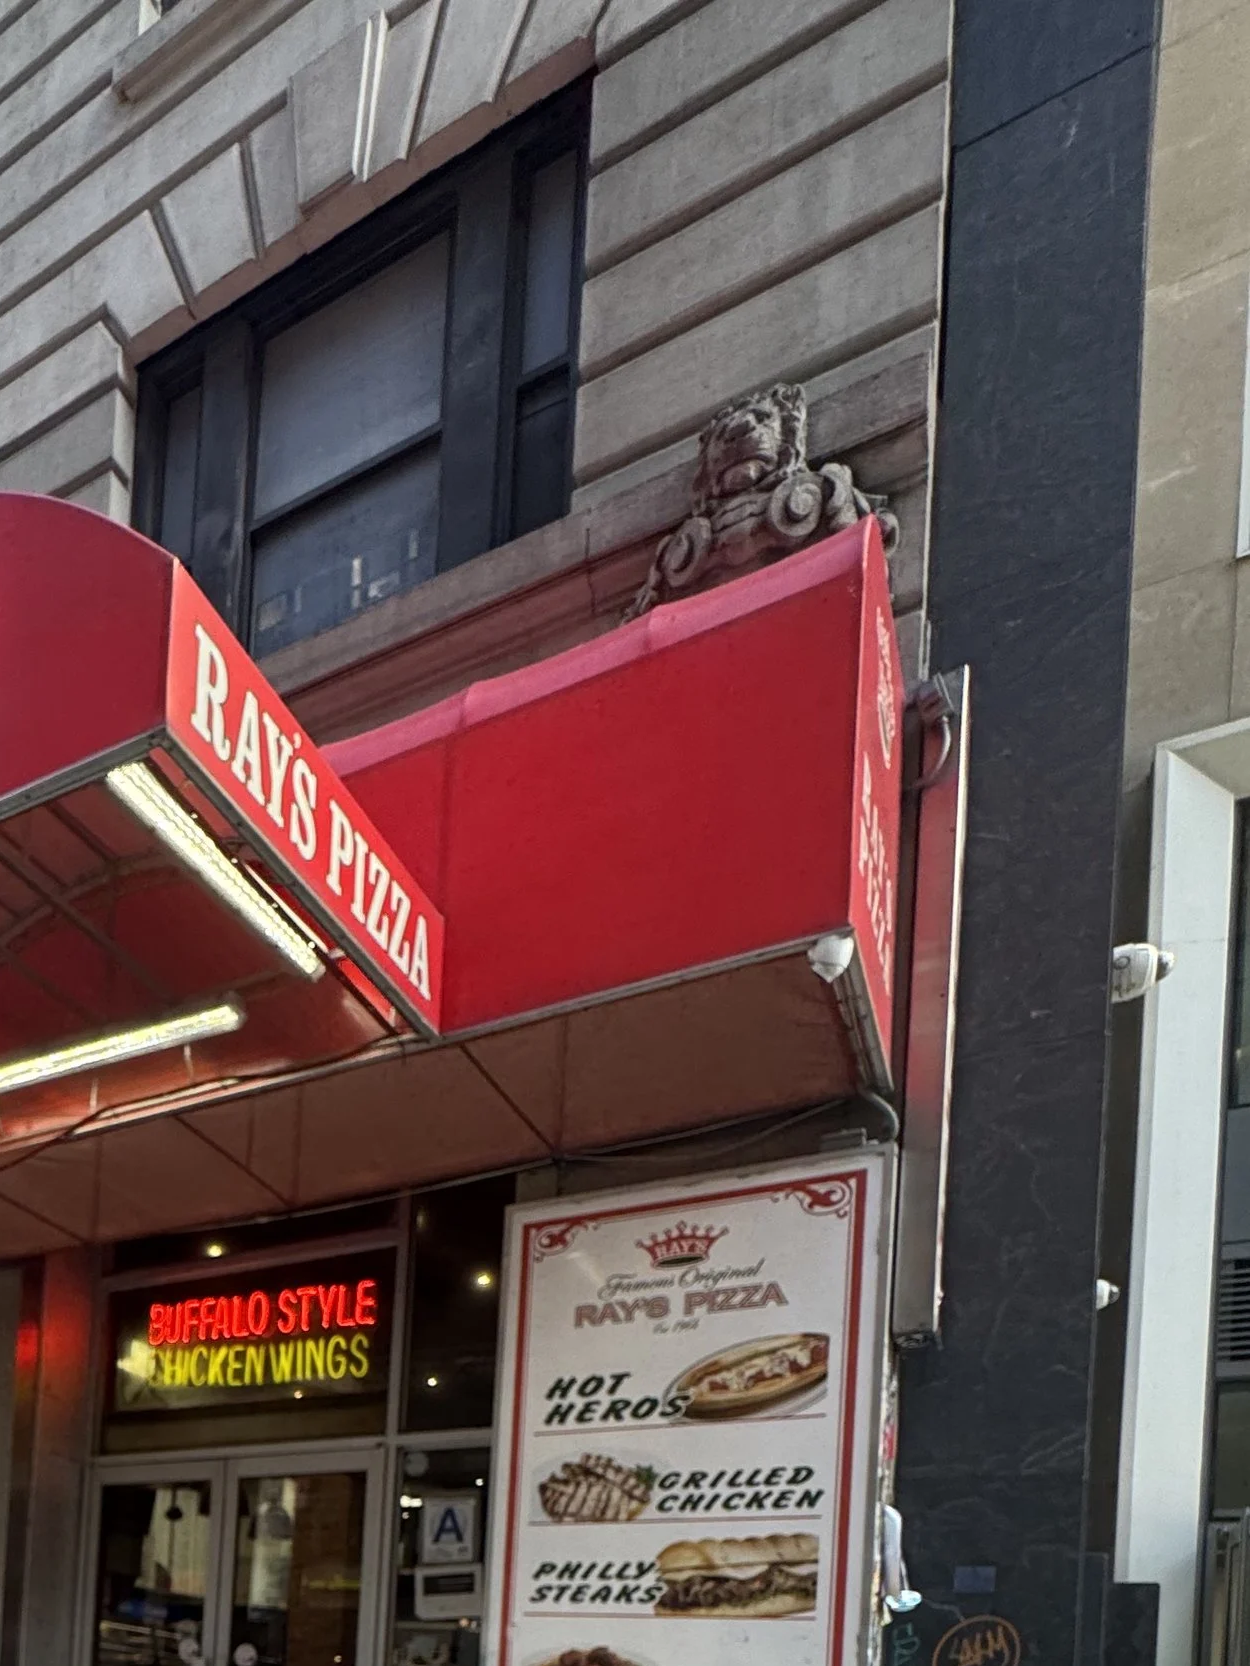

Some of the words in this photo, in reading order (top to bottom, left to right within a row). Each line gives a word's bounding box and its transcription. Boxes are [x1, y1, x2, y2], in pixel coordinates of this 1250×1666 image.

[194, 622, 319, 862] RAY'S
[327, 801, 433, 1001] PIZZA
[597, 1272, 676, 1302] Famous
[678, 1257, 766, 1291] Original
[148, 1291, 270, 1347] BUFFALO
[277, 1280, 377, 1334] STYLE
[573, 1294, 670, 1330] RAY'S
[683, 1279, 789, 1317] PIZZA
[269, 1333, 370, 1384] WINGS
[544, 1371, 631, 1402] HOT
[543, 1394, 693, 1427] HEROS
[657, 1465, 816, 1492] GRILLED
[654, 1486, 826, 1513] CHICKEN
[433, 1507, 465, 1546] A
[530, 1560, 658, 1582] PHILLY
[527, 1582, 669, 1606] STEAKS
